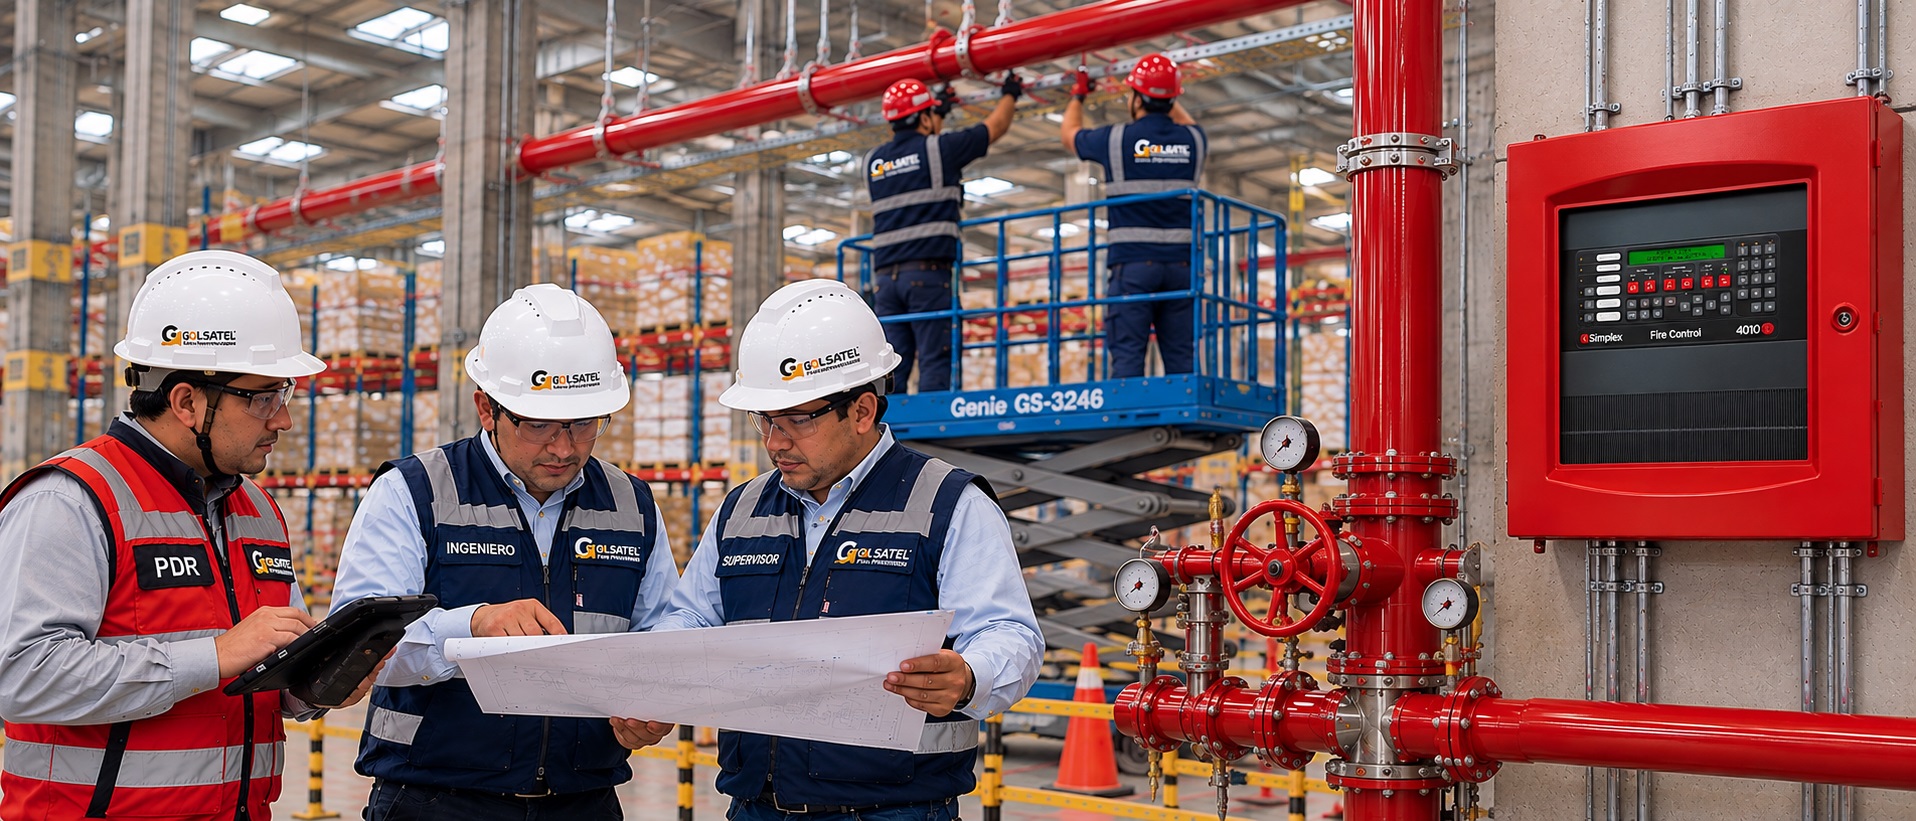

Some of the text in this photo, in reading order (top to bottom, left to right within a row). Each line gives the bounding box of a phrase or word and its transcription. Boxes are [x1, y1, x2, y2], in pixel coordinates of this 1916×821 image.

[182, 330, 236, 341] GOLSATEL
[1650, 328, 1702, 340] Fire Control
[1735, 324, 1761, 335] 4010
[1589, 332, 1623, 344] Simplex
[804, 346, 860, 371] GOLSATEL
[552, 371, 600, 385] GOLSATEL
[951, 388, 1104, 418] Genie GS-3246
[446, 541, 515, 556] INGENIERO
[154, 556, 201, 578] PDR
[722, 553, 779, 567] SUPERVISOR
